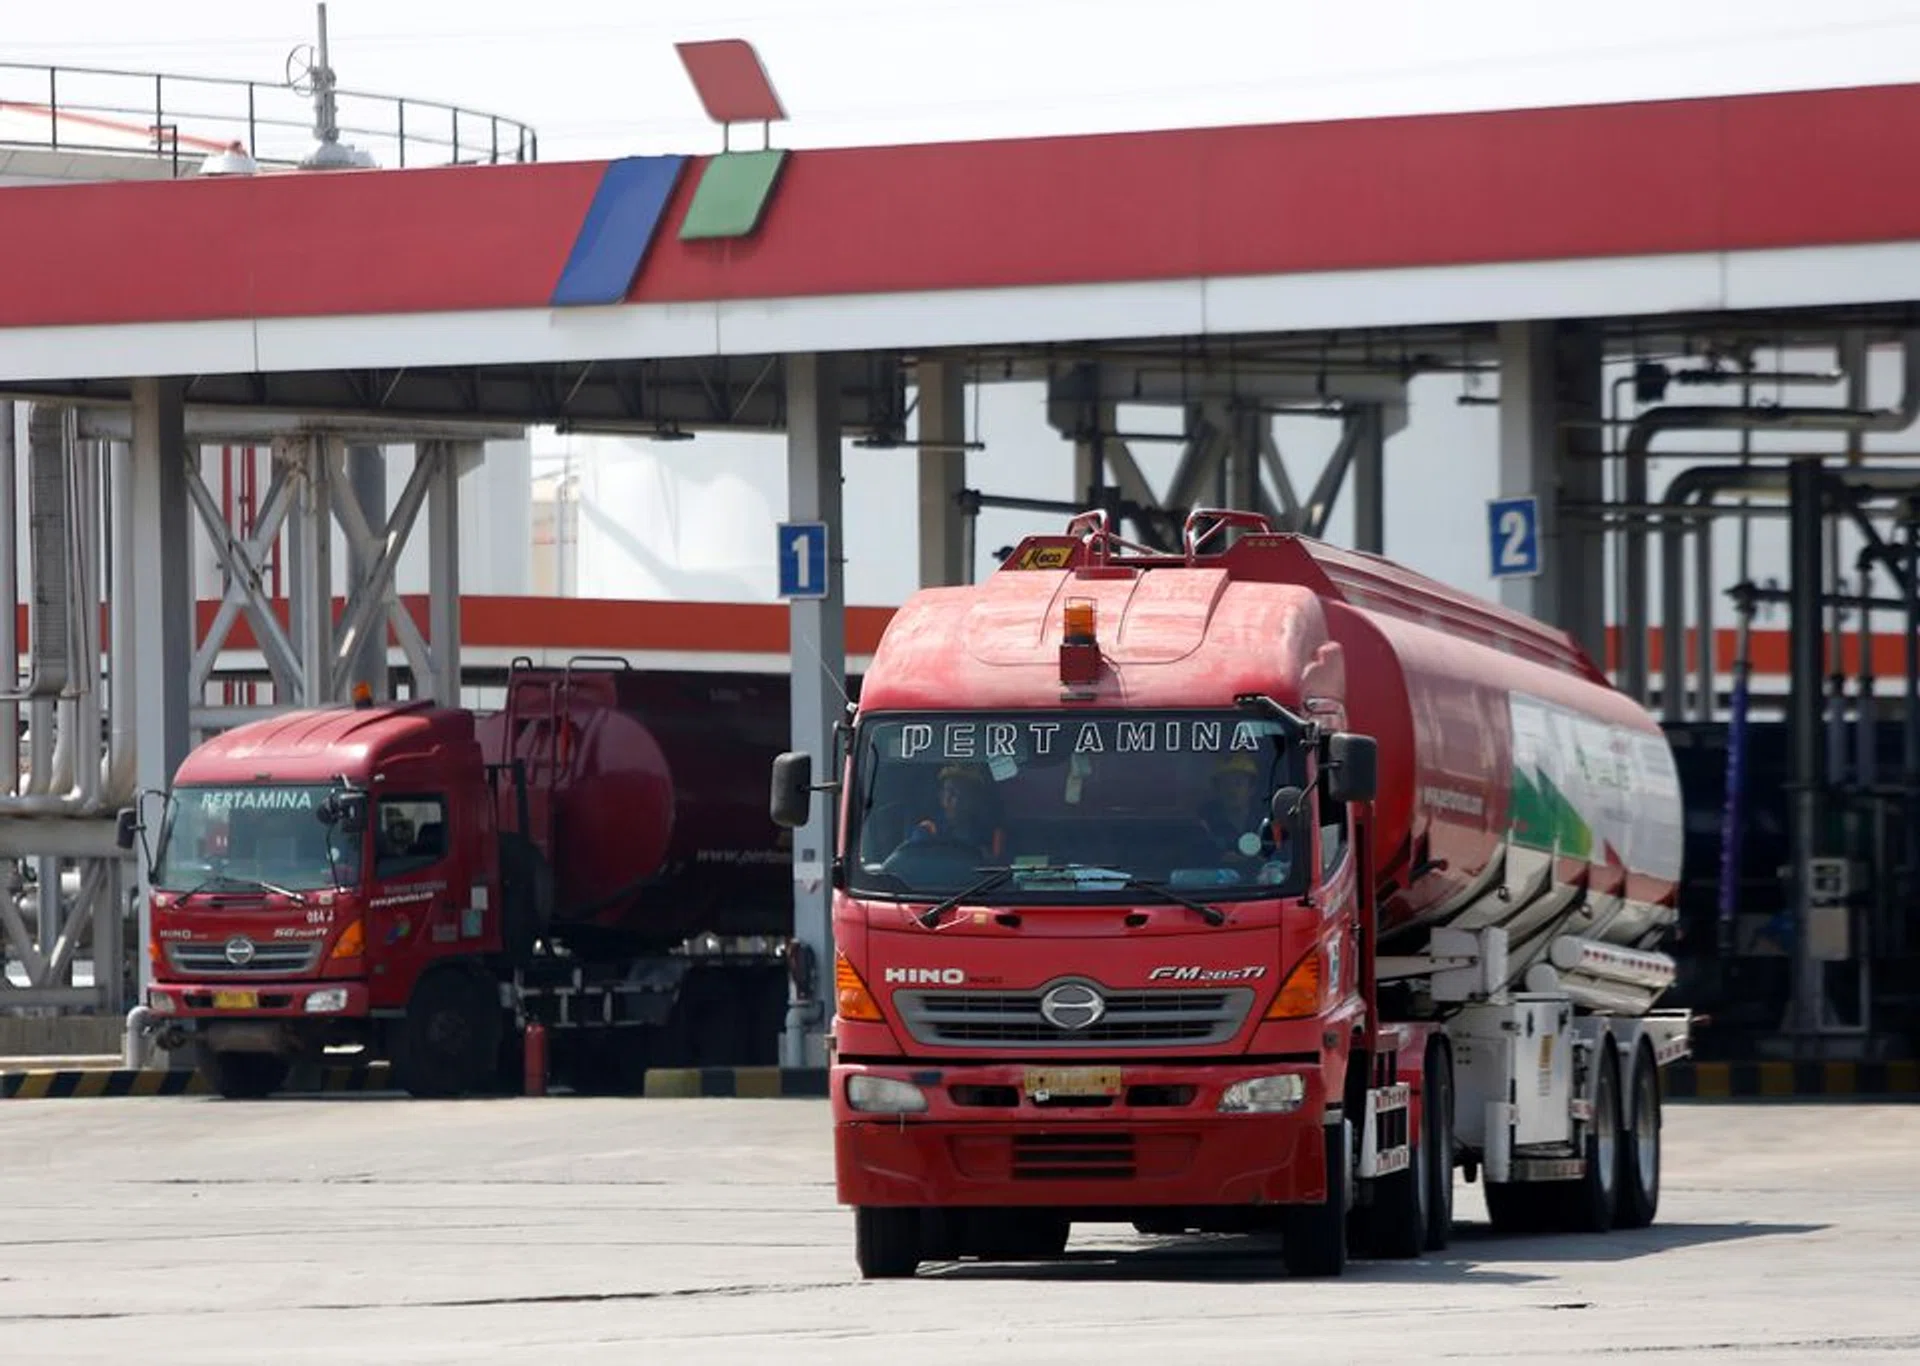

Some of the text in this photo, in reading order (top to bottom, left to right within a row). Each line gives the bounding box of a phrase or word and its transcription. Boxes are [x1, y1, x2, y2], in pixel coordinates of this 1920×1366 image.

[1500, 511, 1528, 567] 2
[791, 534, 809, 588] 1
[901, 721, 1260, 759] PERTAMINA
[201, 788, 312, 811] PERTAMINA
[885, 967, 965, 985] HINO
